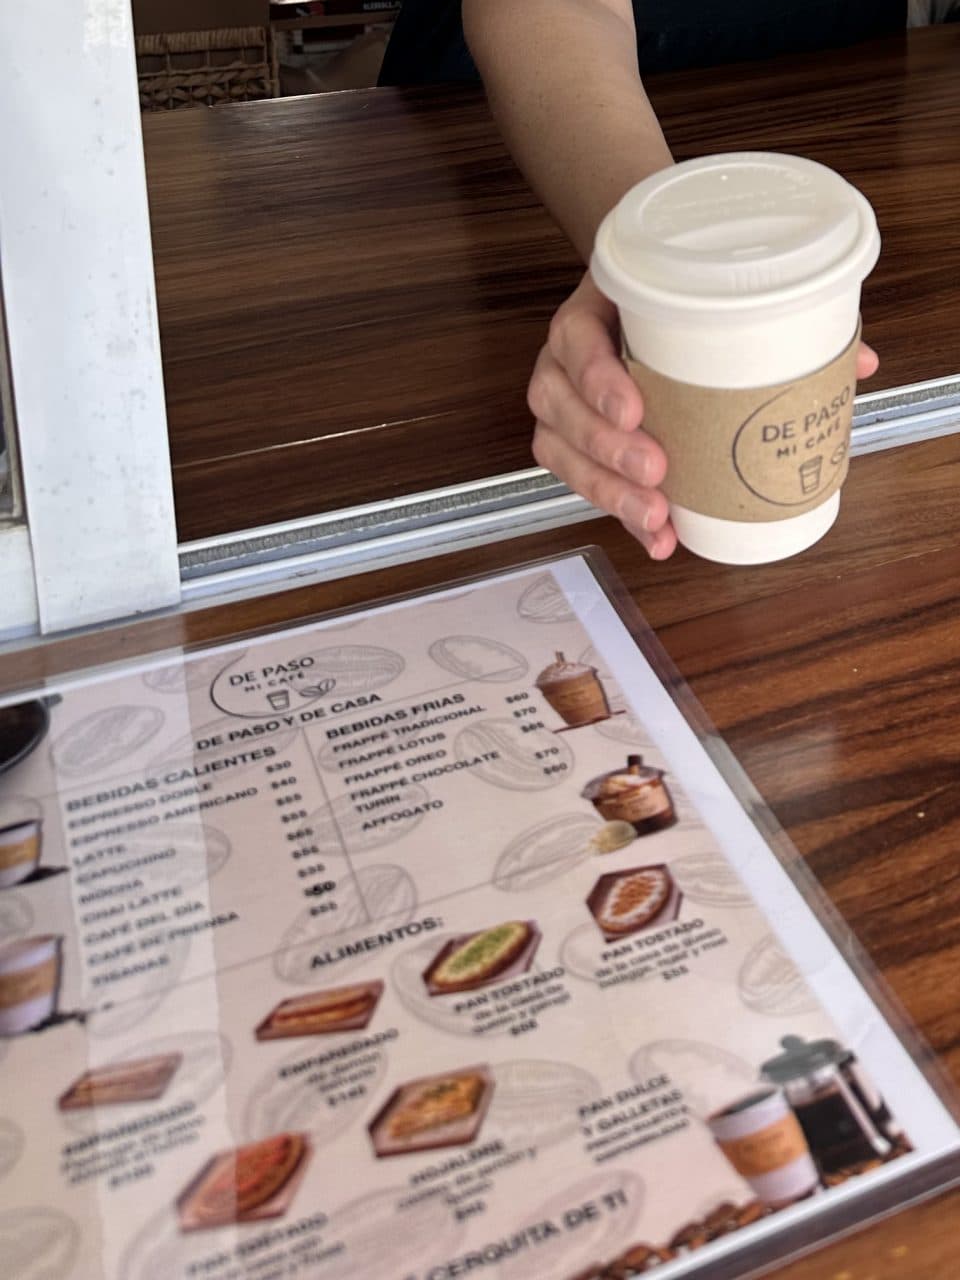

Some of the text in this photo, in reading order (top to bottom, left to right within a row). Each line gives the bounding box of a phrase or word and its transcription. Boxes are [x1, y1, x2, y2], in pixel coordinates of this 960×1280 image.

[762, 385, 850, 443] DE PASO
[776, 444, 797, 459] MI
[229, 657, 315, 687] DE PASO
[244, 683, 262, 693] MI
[195, 693, 382, 751] DE PASO Y DE CASA
[325, 693, 466, 740] BEBIDAS FRIAS
[392, 704, 487, 736] TRADICIONAL
[400, 732, 446, 752] LOTUS
[405, 749, 447, 768] OREO
[66, 745, 277, 813] BEBIDAS CALIENTES
[412, 751, 500, 784] CHOCOLATE
[158, 782, 213, 804] DOBLE
[163, 787, 259, 821] AMERICANO
[361, 799, 444, 832] AFFOGATO
[73, 843, 128, 866] LATTE
[310, 917, 445, 969] ALIMENTOS:
[601, 918, 705, 962] PAN TOSTADO
[453, 966, 566, 1013] PAN TOSTADO
[562, 1201, 599, 1232] DE
[602, 1188, 629, 1213] TI
